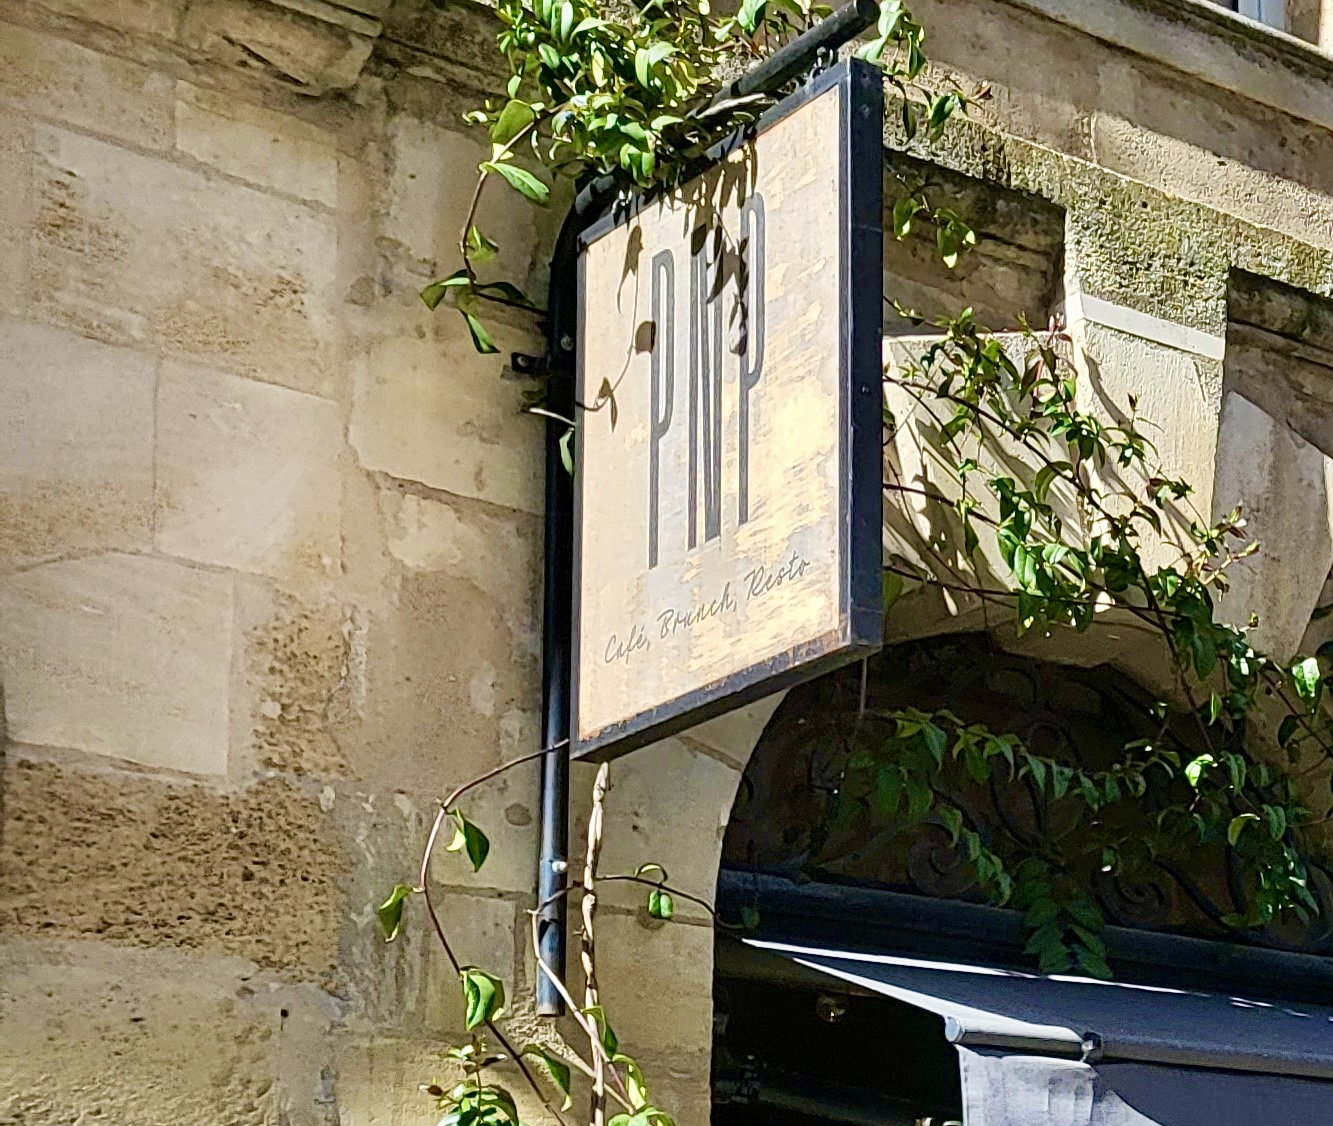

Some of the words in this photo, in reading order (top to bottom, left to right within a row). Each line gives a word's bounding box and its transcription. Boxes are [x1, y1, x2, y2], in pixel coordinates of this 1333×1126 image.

[648, 191, 766, 571] PNP
[656, 580, 738, 640] Brunch,
[744, 550, 811, 601] Resto
